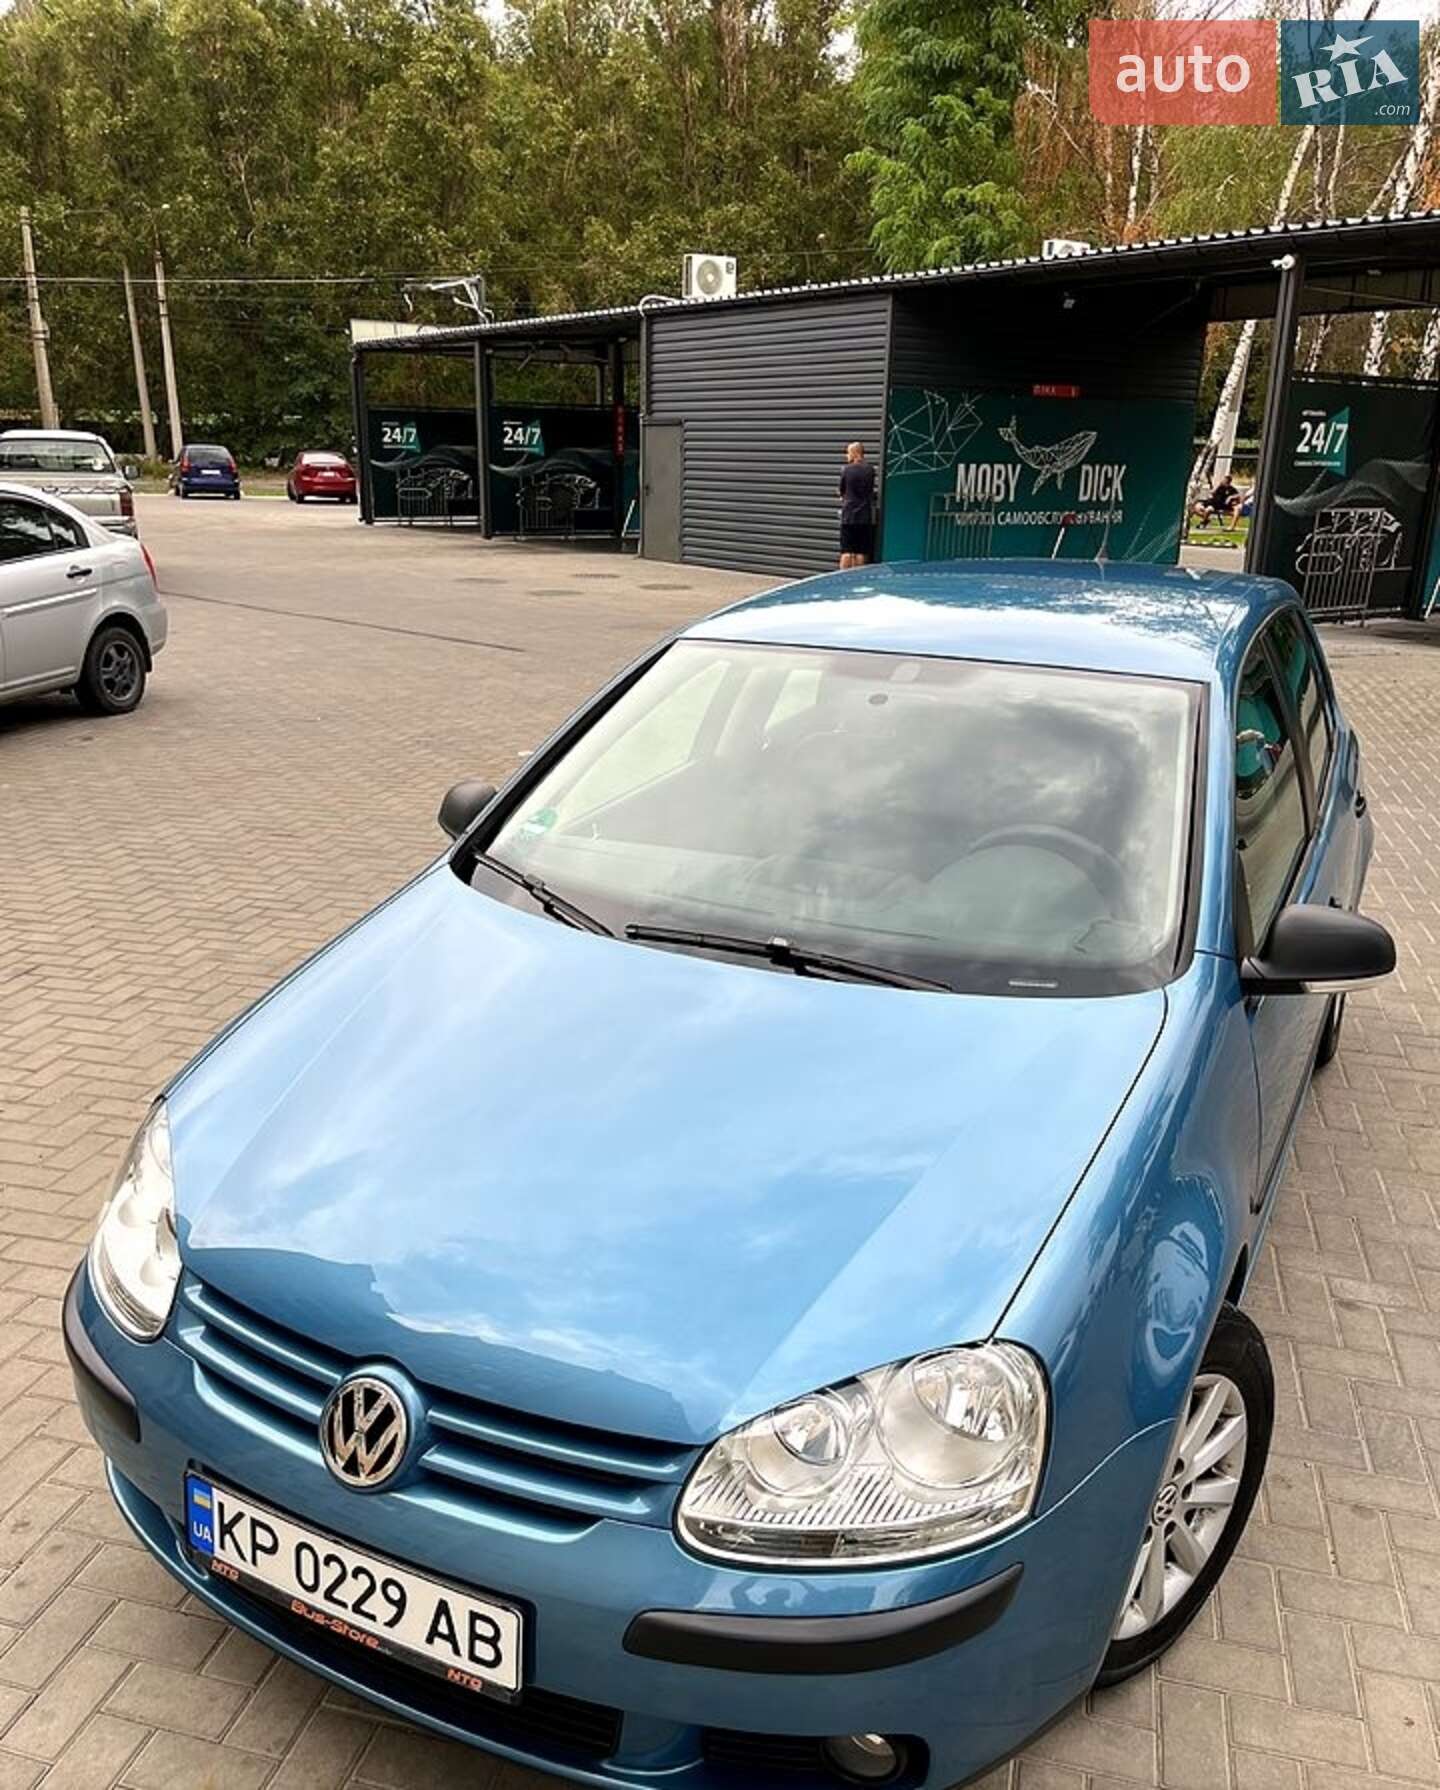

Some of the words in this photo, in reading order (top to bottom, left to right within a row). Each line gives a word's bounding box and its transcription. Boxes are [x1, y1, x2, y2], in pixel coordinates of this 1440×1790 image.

[381, 427, 417, 444] 24/7
[503, 426, 541, 446] 24/7
[1296, 421, 1349, 455] 24/7
[955, 463, 1023, 503] MOBY
[1078, 463, 1127, 502] DICK
[193, 1520, 213, 1543] UA
[217, 1501, 280, 1567] KP
[294, 1541, 408, 1629] 0229
[424, 1598, 503, 1670] AB
